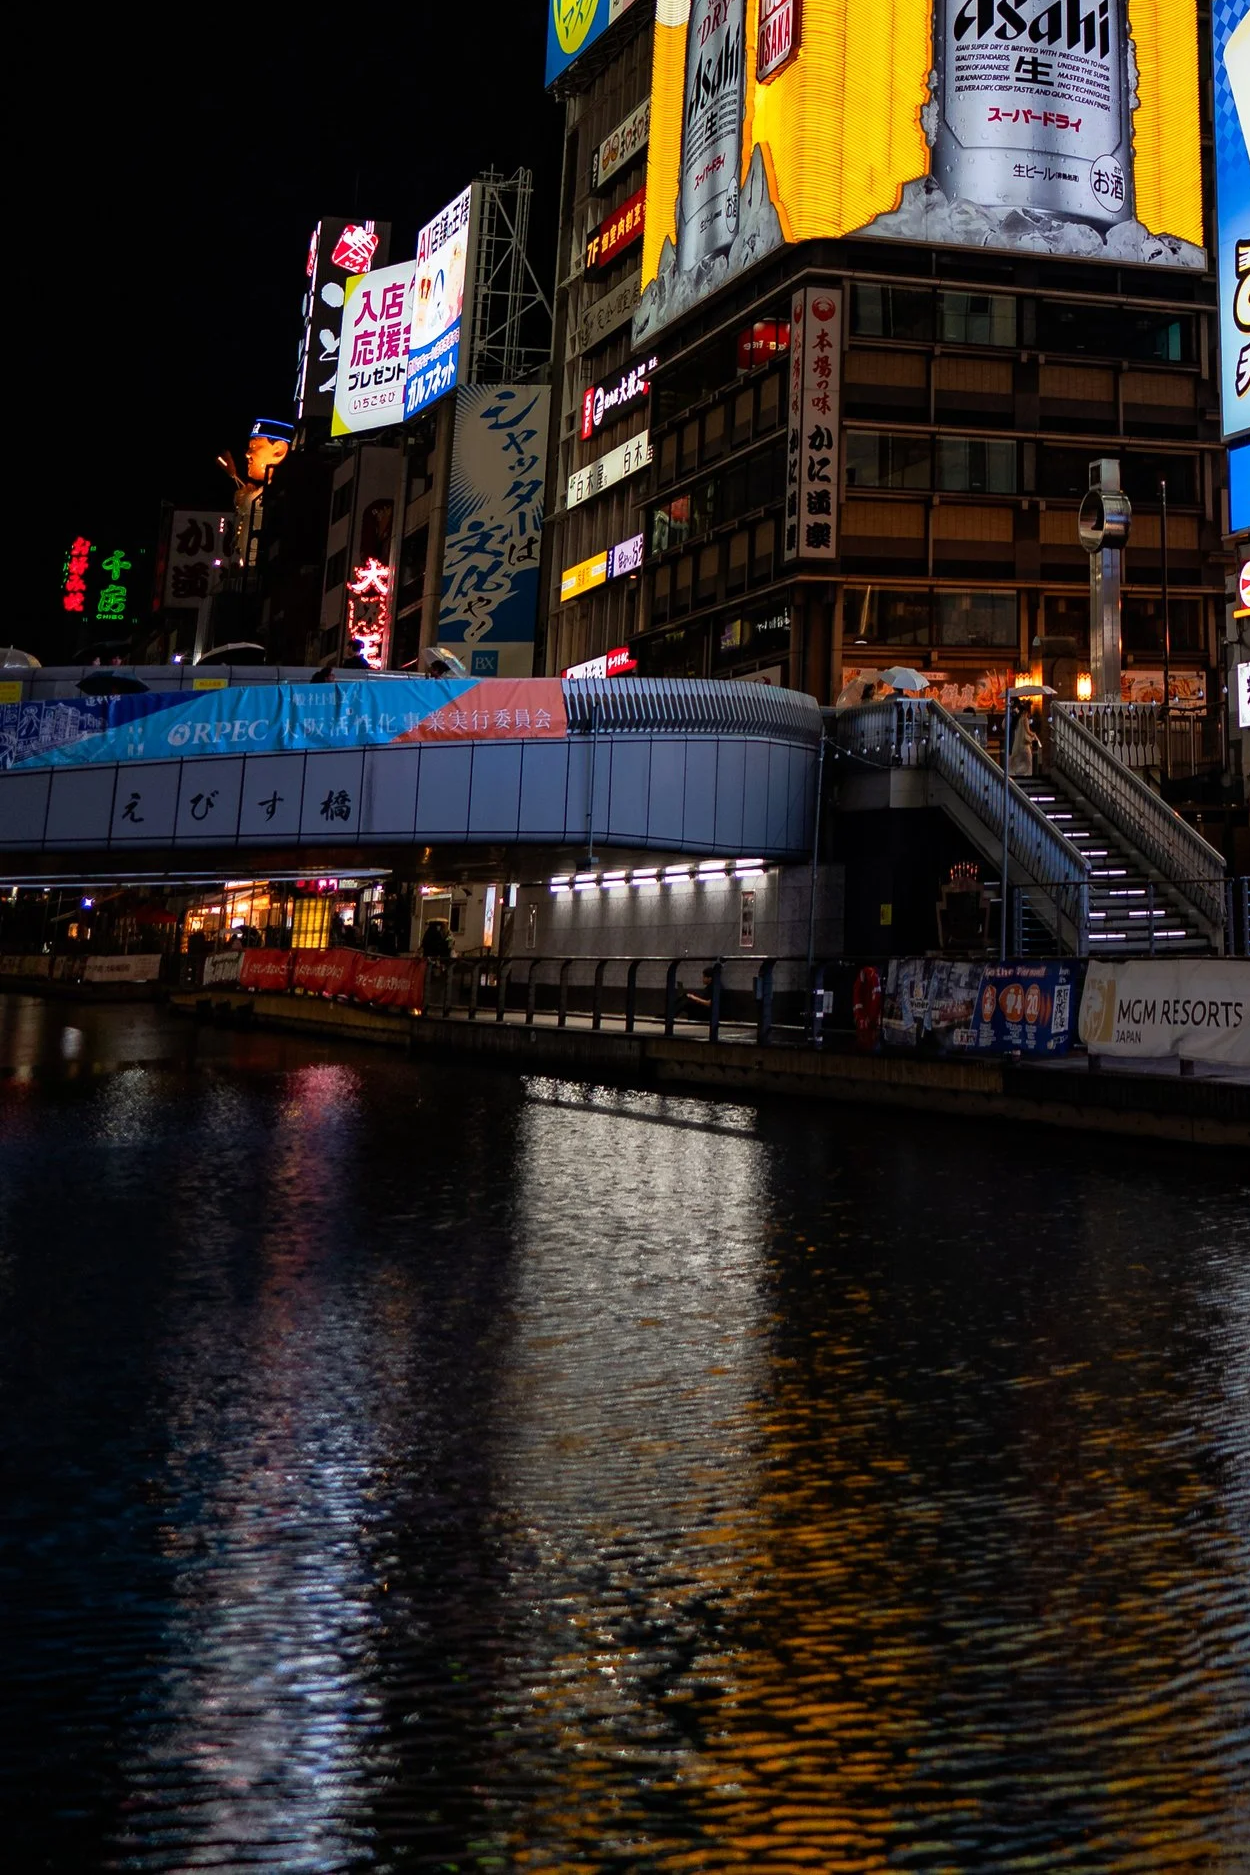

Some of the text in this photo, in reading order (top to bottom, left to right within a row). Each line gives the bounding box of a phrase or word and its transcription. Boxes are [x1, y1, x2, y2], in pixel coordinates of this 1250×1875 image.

[758, 5, 792, 72] OSAKA
[1011, 45, 1038, 54] BREWED
[1040, 48, 1057, 57] WITH
[1058, 51, 1089, 65] PRECISION
[688, 20, 741, 125] Asahi
[1014, 55, 1055, 87] 生
[1057, 62, 1080, 72] UNDER
[1081, 67, 1093, 75] THE
[1057, 72, 1085, 83] MASTER
[1014, 86, 1034, 94] TASTE
[1034, 88, 1050, 96] AND
[1075, 95, 1094, 106] CLEAN
[1057, 82, 1110, 101] ING TECHNIQUES
[987, 107, 1082, 133] スーパードライ
[1093, 169, 1124, 202] お酒
[354, 282, 405, 328] 入店
[348, 362, 406, 391] プレゼント
[407, 352, 455, 413] ガルフネット
[812, 328, 833, 416] 本場の味
[480, 390, 541, 566] シャッターは
[806, 424, 834, 550] かに道楽
[98, 549, 132, 613] 千房
[280, 707, 552, 740] 大阪活性化事業実行委員会
[121, 788, 353, 823] えびす橋
[1118, 999, 1244, 1028] MGM RESORTS
[1115, 1030, 1142, 1044] JAPAN
